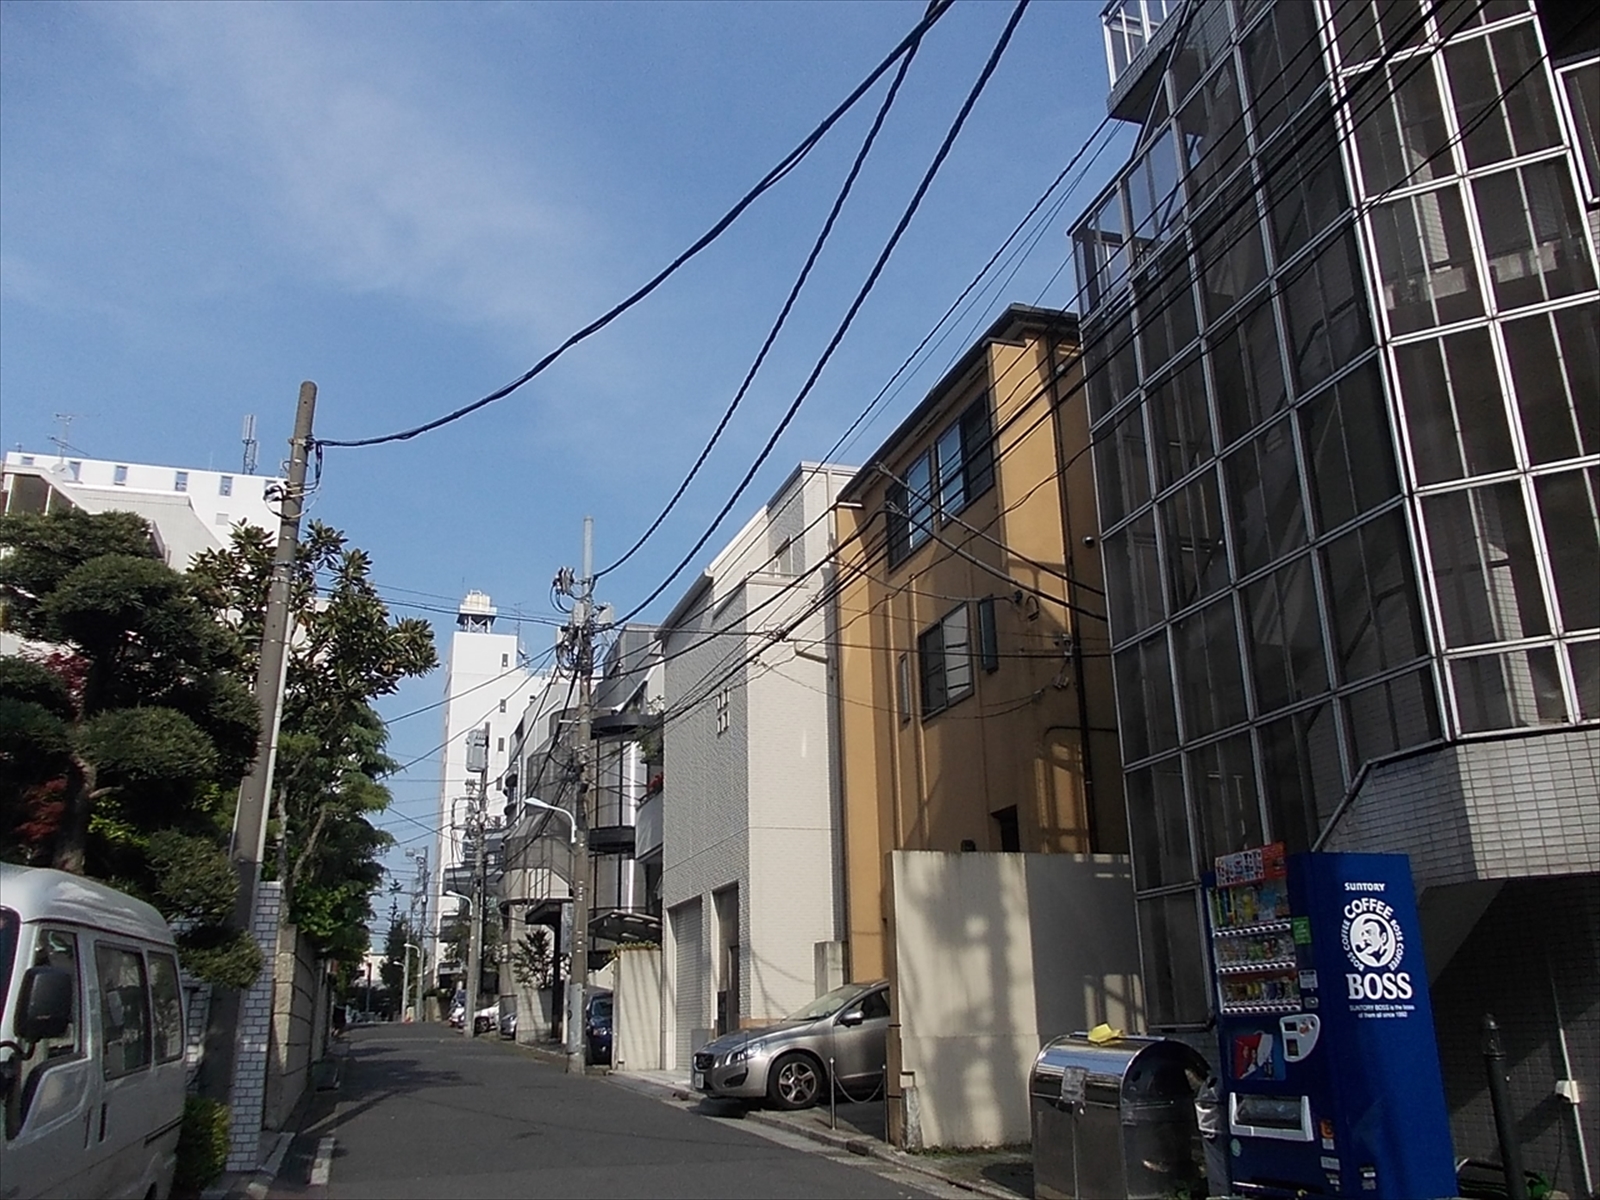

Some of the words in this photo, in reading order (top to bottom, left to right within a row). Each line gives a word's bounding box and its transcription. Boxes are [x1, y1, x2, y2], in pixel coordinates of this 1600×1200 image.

[1344, 897, 1394, 920] COFFEE
[1341, 919, 1351, 951] COFFEE
[1390, 919, 1404, 941] BOSS
[1347, 952, 1365, 972] BOSS
[1388, 942, 1405, 971] COFFEE
[1345, 972, 1413, 1000] BOSS
